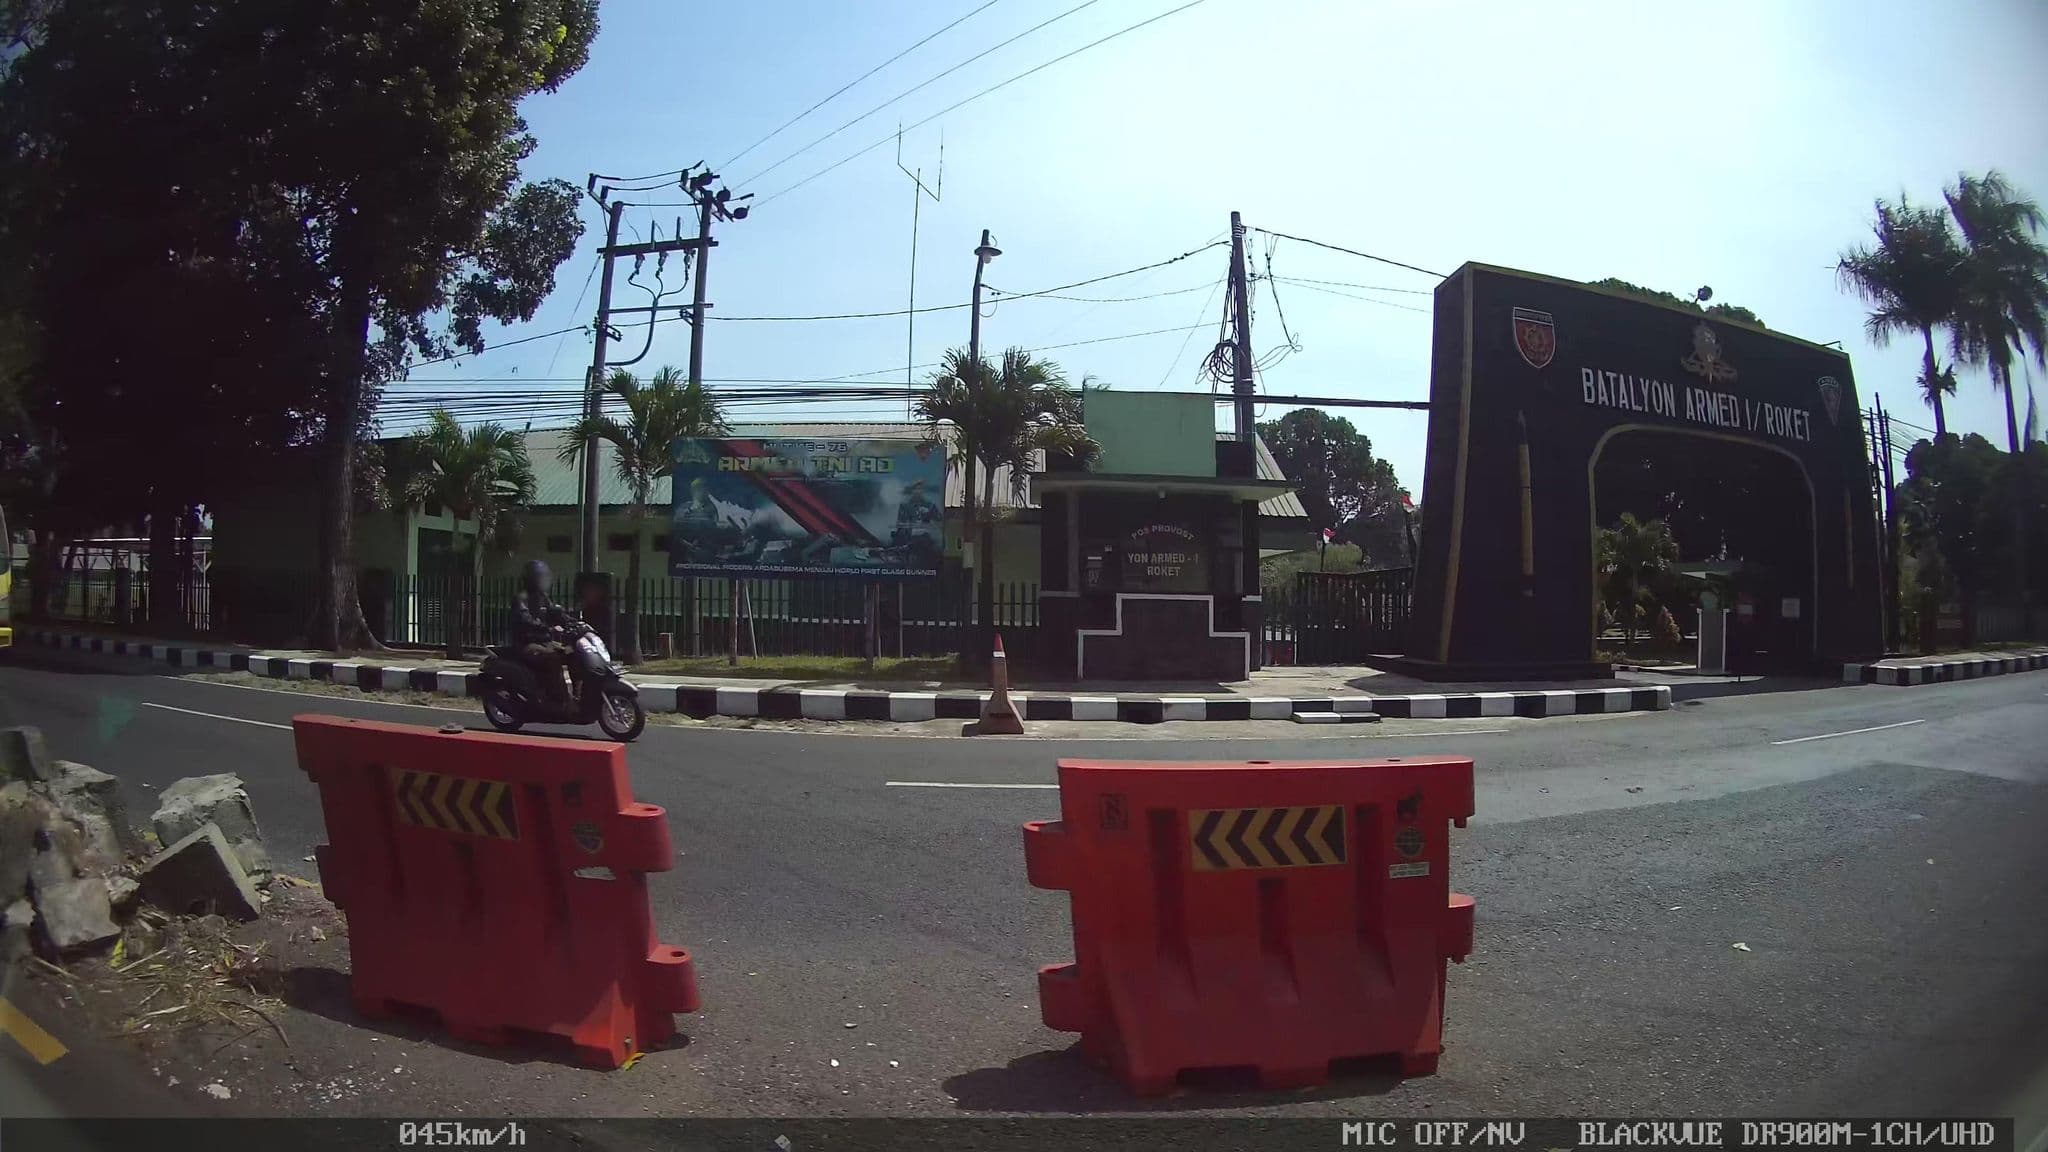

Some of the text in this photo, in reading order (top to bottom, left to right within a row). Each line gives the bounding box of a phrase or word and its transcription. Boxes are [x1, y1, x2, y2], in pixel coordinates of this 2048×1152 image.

[1582, 366, 1676, 418] BATALYON
[1686, 386, 1740, 428] ARMED
[1151, 524, 1195, 541] PROVOST
[1128, 552, 1149, 564] YON
[1151, 552, 1185, 565] ARMED
[1147, 566, 1181, 577] ROKET
